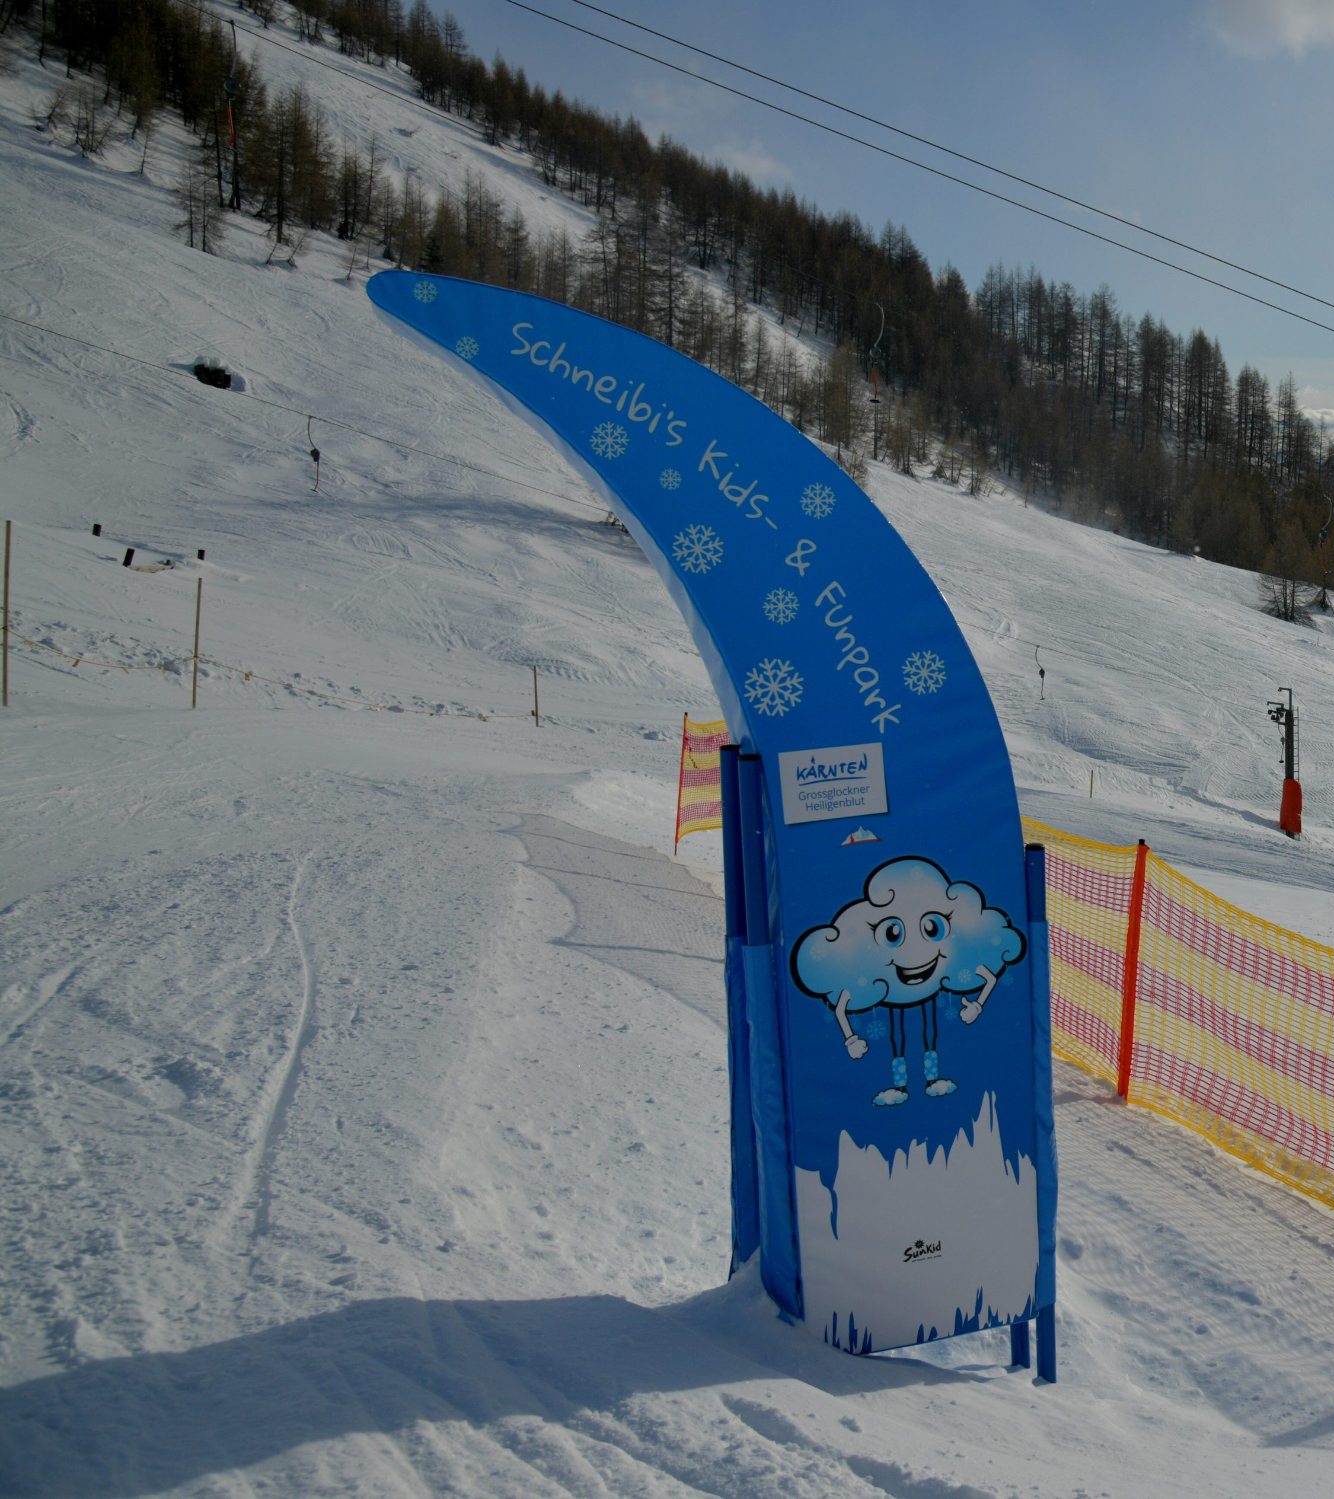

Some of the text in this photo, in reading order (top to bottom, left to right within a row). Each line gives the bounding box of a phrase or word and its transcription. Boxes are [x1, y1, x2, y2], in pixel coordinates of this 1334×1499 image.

[511, 322, 688, 447] Schneibi's
[785, 539, 817, 577] &
[796, 752, 868, 781] KÄRNTEN
[798, 785, 871, 801] Grossglockner
[805, 797, 865, 812] Heiligenblut
